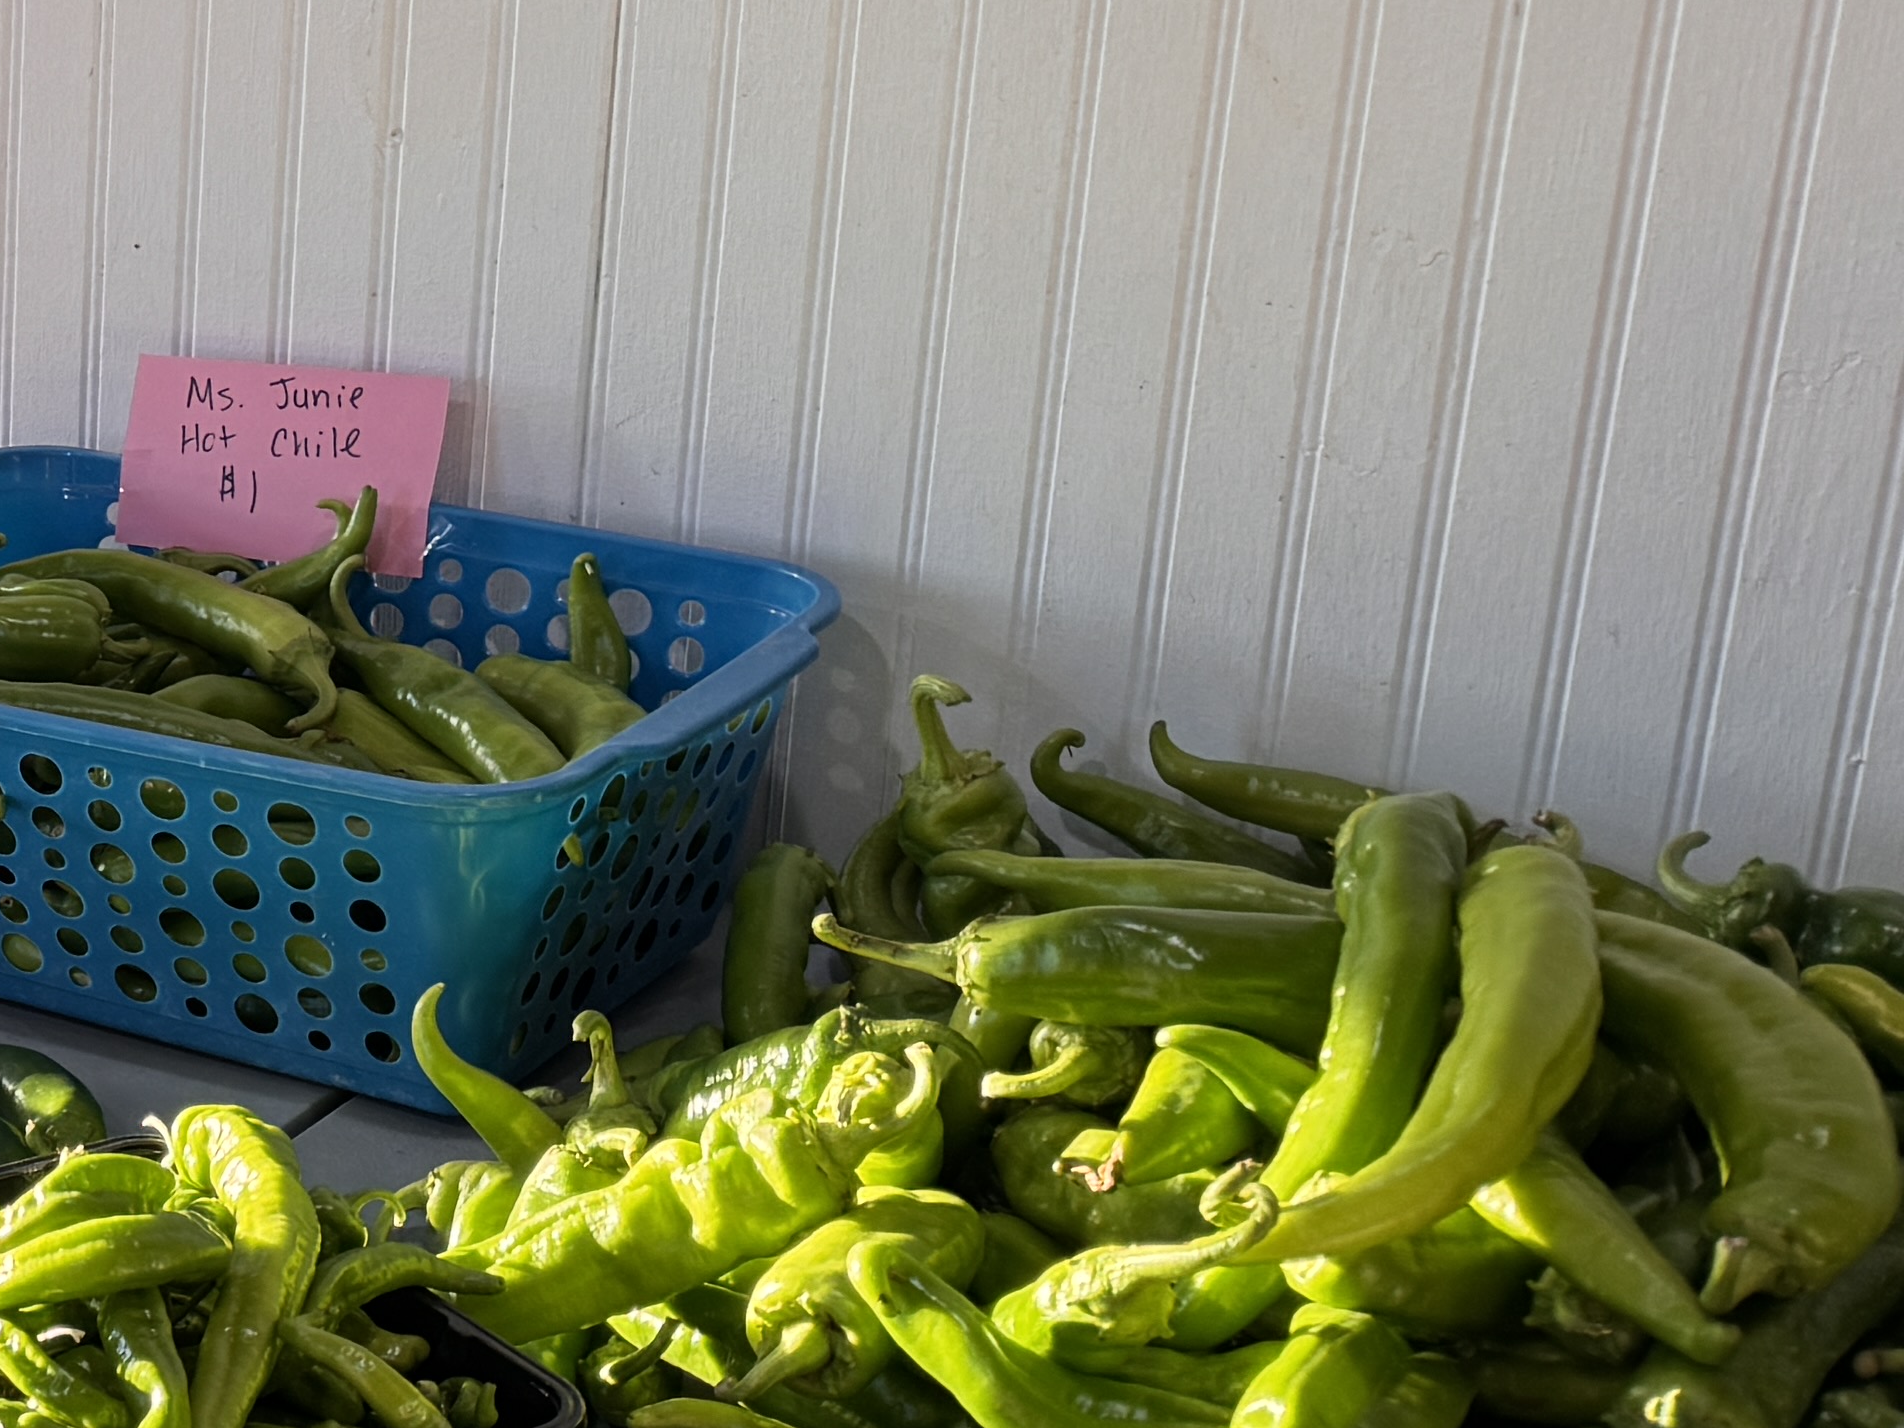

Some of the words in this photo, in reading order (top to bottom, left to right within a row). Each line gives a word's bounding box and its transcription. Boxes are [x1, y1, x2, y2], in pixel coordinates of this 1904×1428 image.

[186, 375, 244, 412] Ms.
[269, 376, 364, 411] Junie
[181, 423, 237, 455] Hot
[270, 426, 362, 458] Chile
[219, 464, 257, 514] $1
